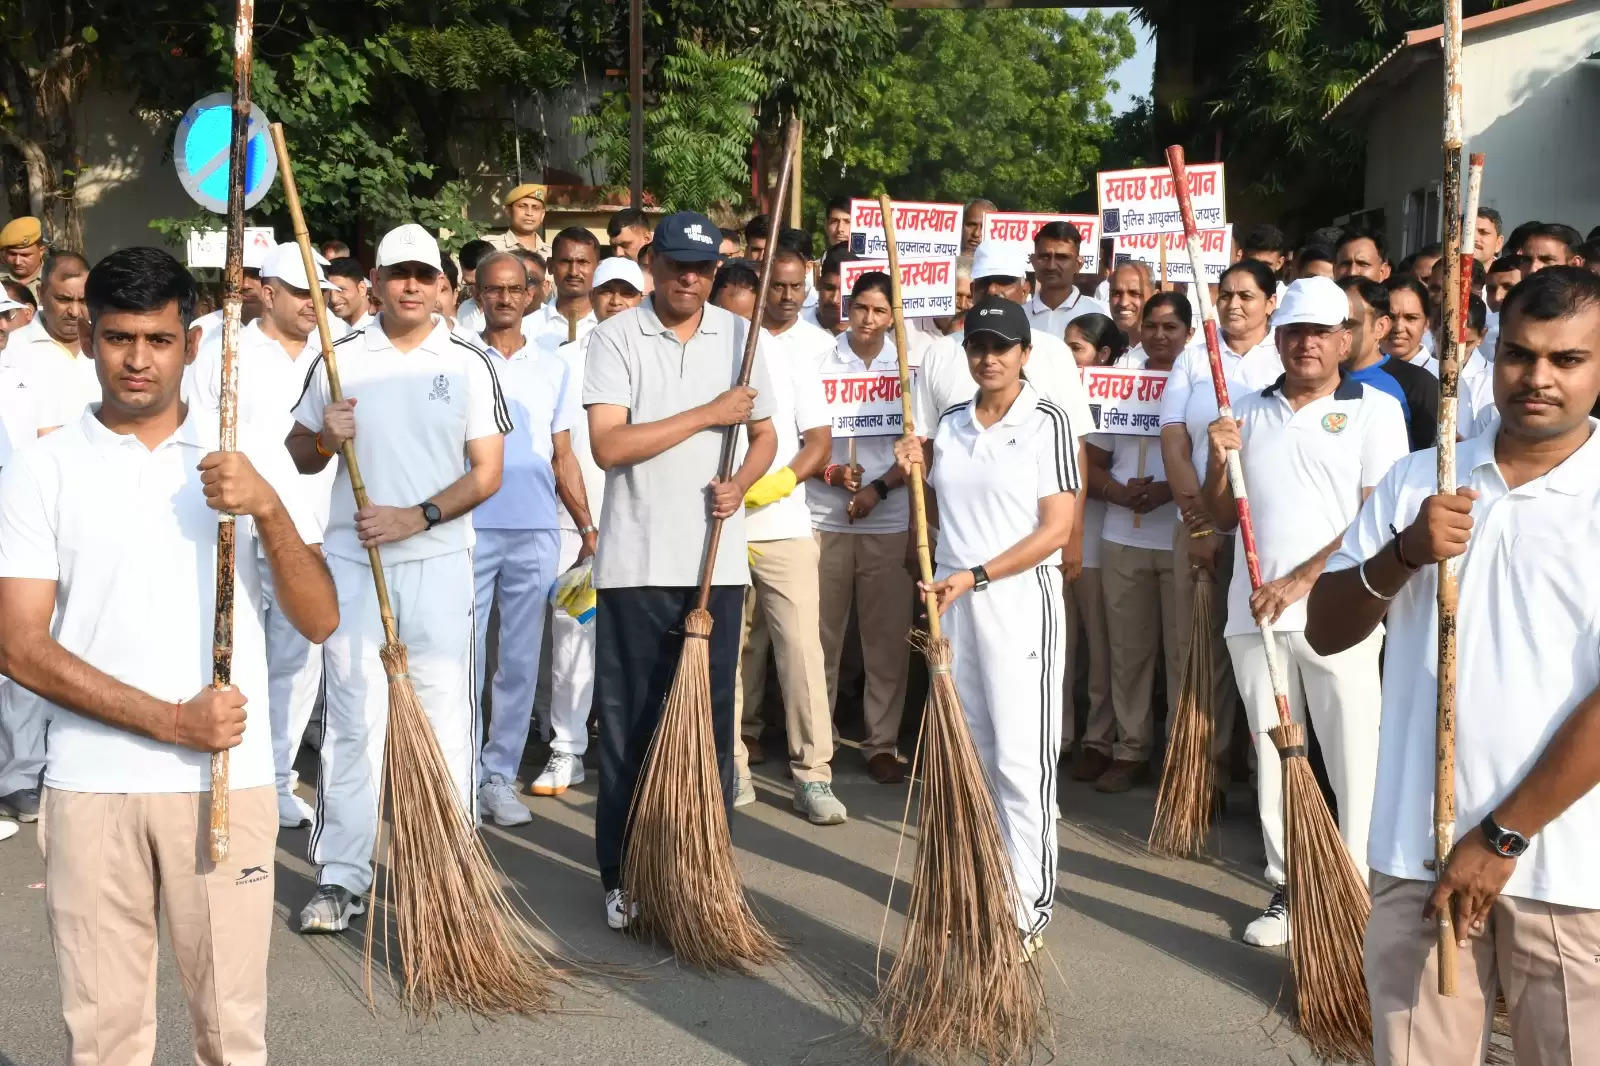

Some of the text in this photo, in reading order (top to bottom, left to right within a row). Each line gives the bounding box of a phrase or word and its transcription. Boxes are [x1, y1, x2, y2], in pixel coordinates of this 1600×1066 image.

[1105, 176, 1147, 203] स्वच्छ
[896, 208, 958, 232] राजस्थान
[990, 219, 1029, 241] स्वच्छ
[1122, 209, 1144, 230] पुलिस
[1195, 208, 1220, 223] जयपुर
[934, 243, 958, 256] जयपुर
[928, 296, 952, 311] जयपुर
[1088, 373, 1136, 400] स्वच्छ
[838, 414, 883, 432] आयुक्तालय
[1103, 407, 1128, 429] पुलिस
